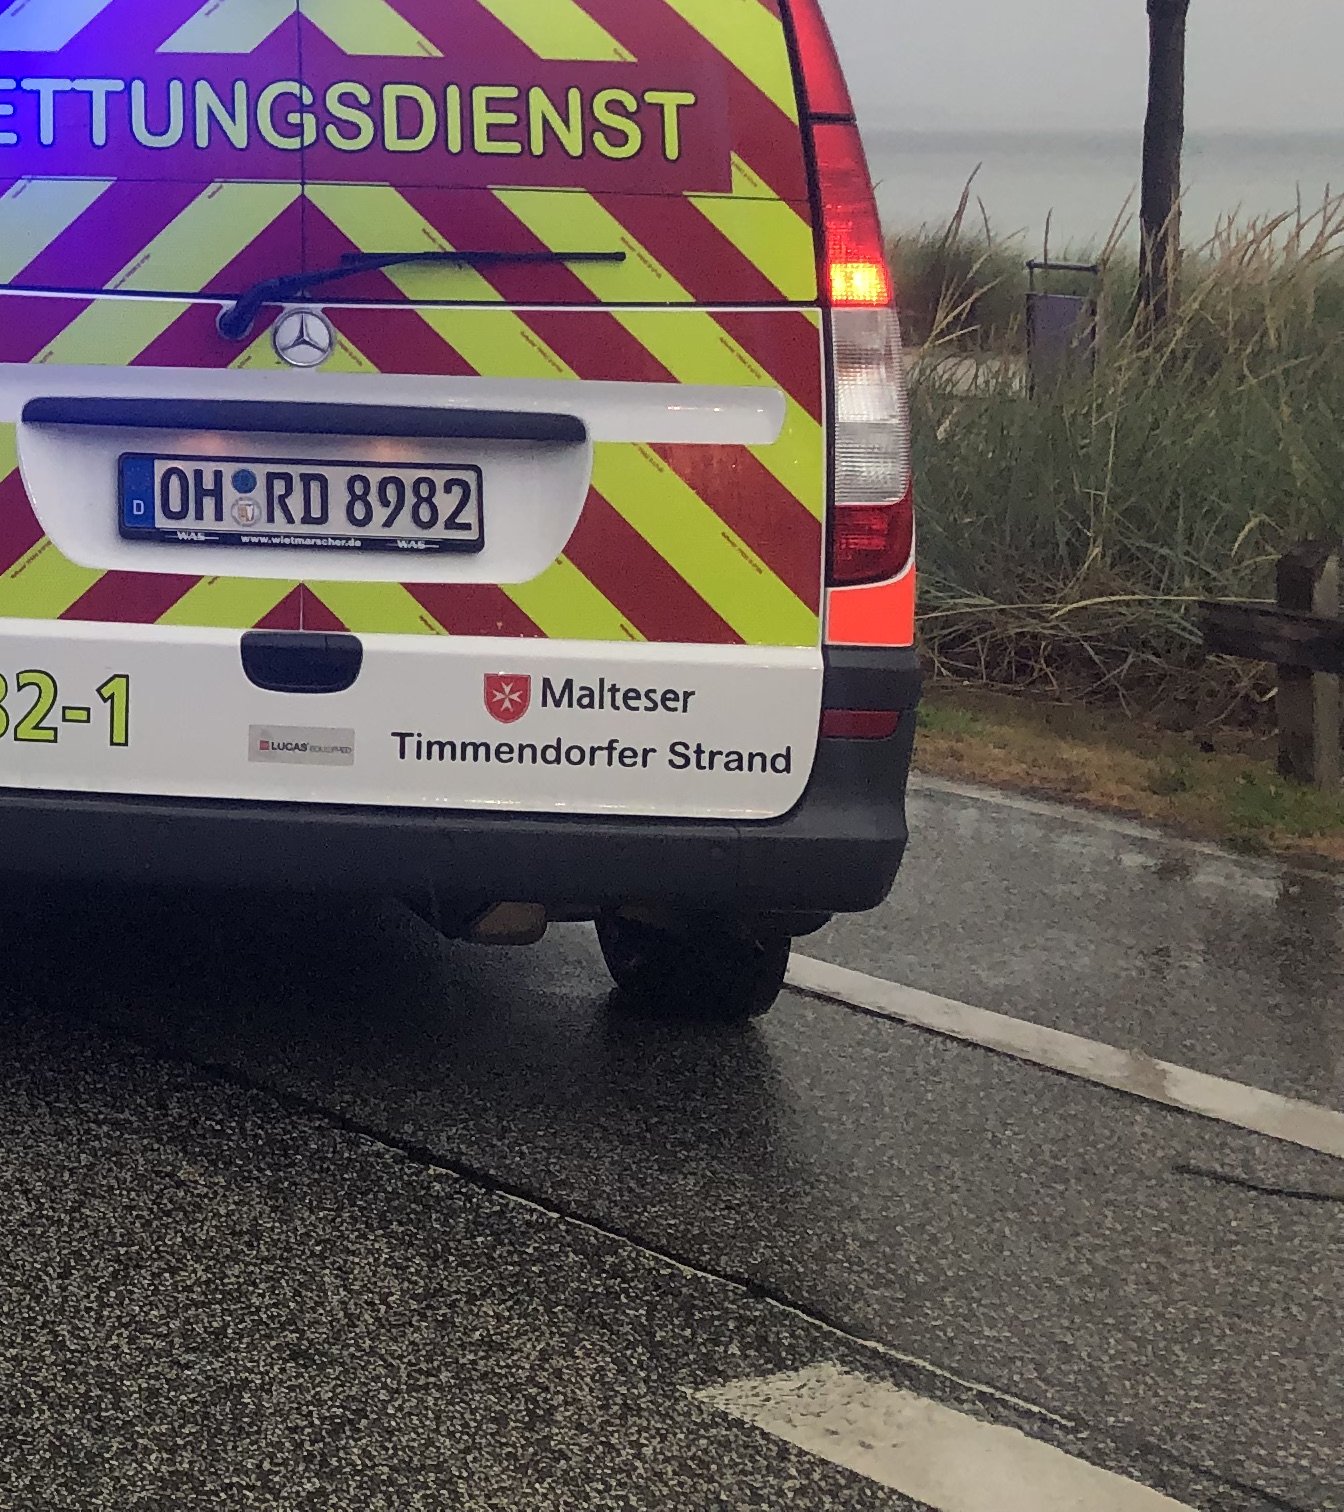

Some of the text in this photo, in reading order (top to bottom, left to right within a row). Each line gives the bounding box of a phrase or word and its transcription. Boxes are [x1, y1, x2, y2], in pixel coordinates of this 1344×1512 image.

[132, 466, 473, 531] D OH RD 8982
[241, 534, 362, 548] www.wietmarscher.de
[541, 677, 696, 714] Malteser
[271, 741, 308, 752] LUCAS
[391, 731, 793, 774] Timmendorfer Strand
